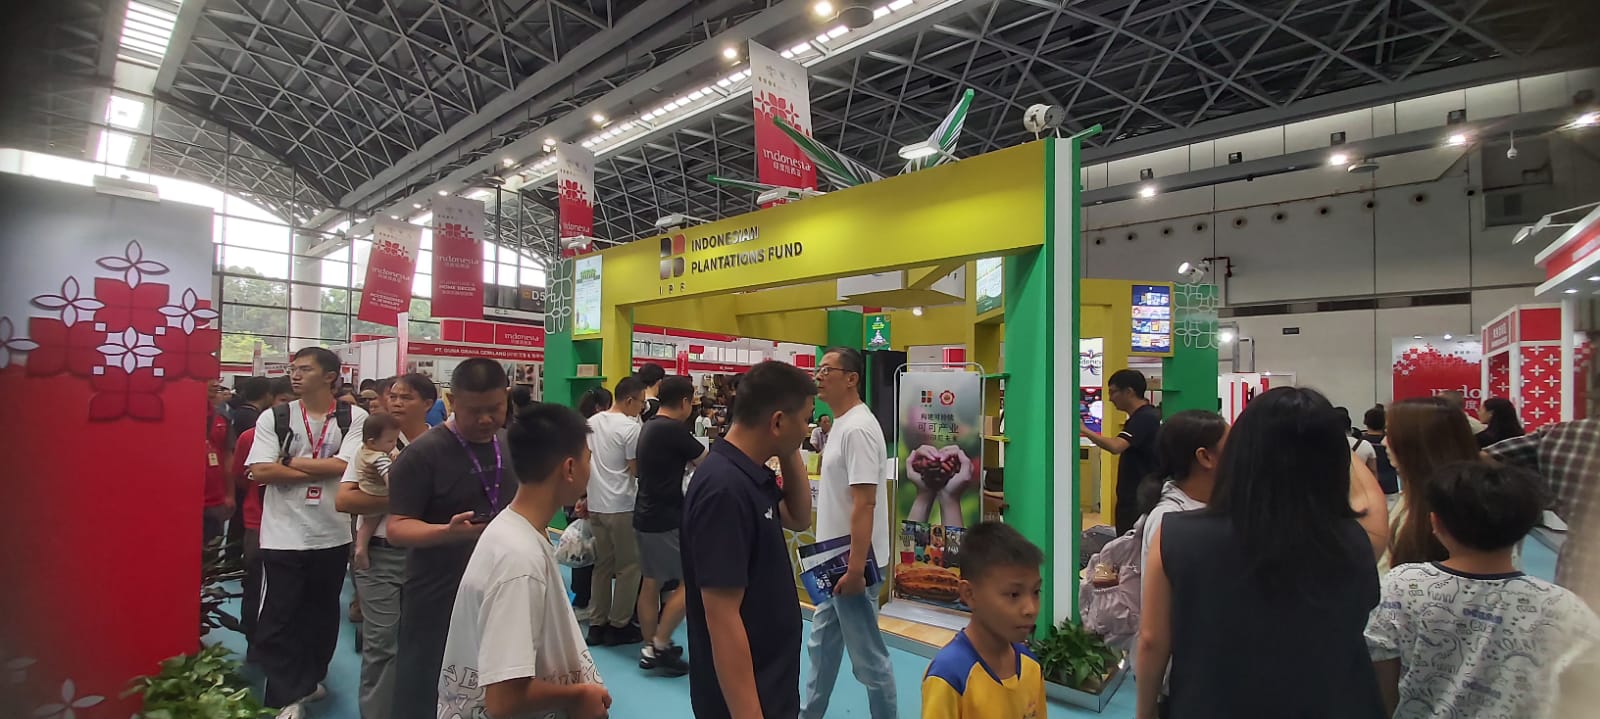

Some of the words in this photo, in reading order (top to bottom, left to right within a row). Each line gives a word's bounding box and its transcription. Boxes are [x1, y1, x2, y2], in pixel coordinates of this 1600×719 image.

[691, 225, 760, 252] INDONESIAN
[691, 248, 765, 274] PLANTATIONS
[768, 241, 803, 261] FUND
[917, 421, 960, 433] 可可产业
